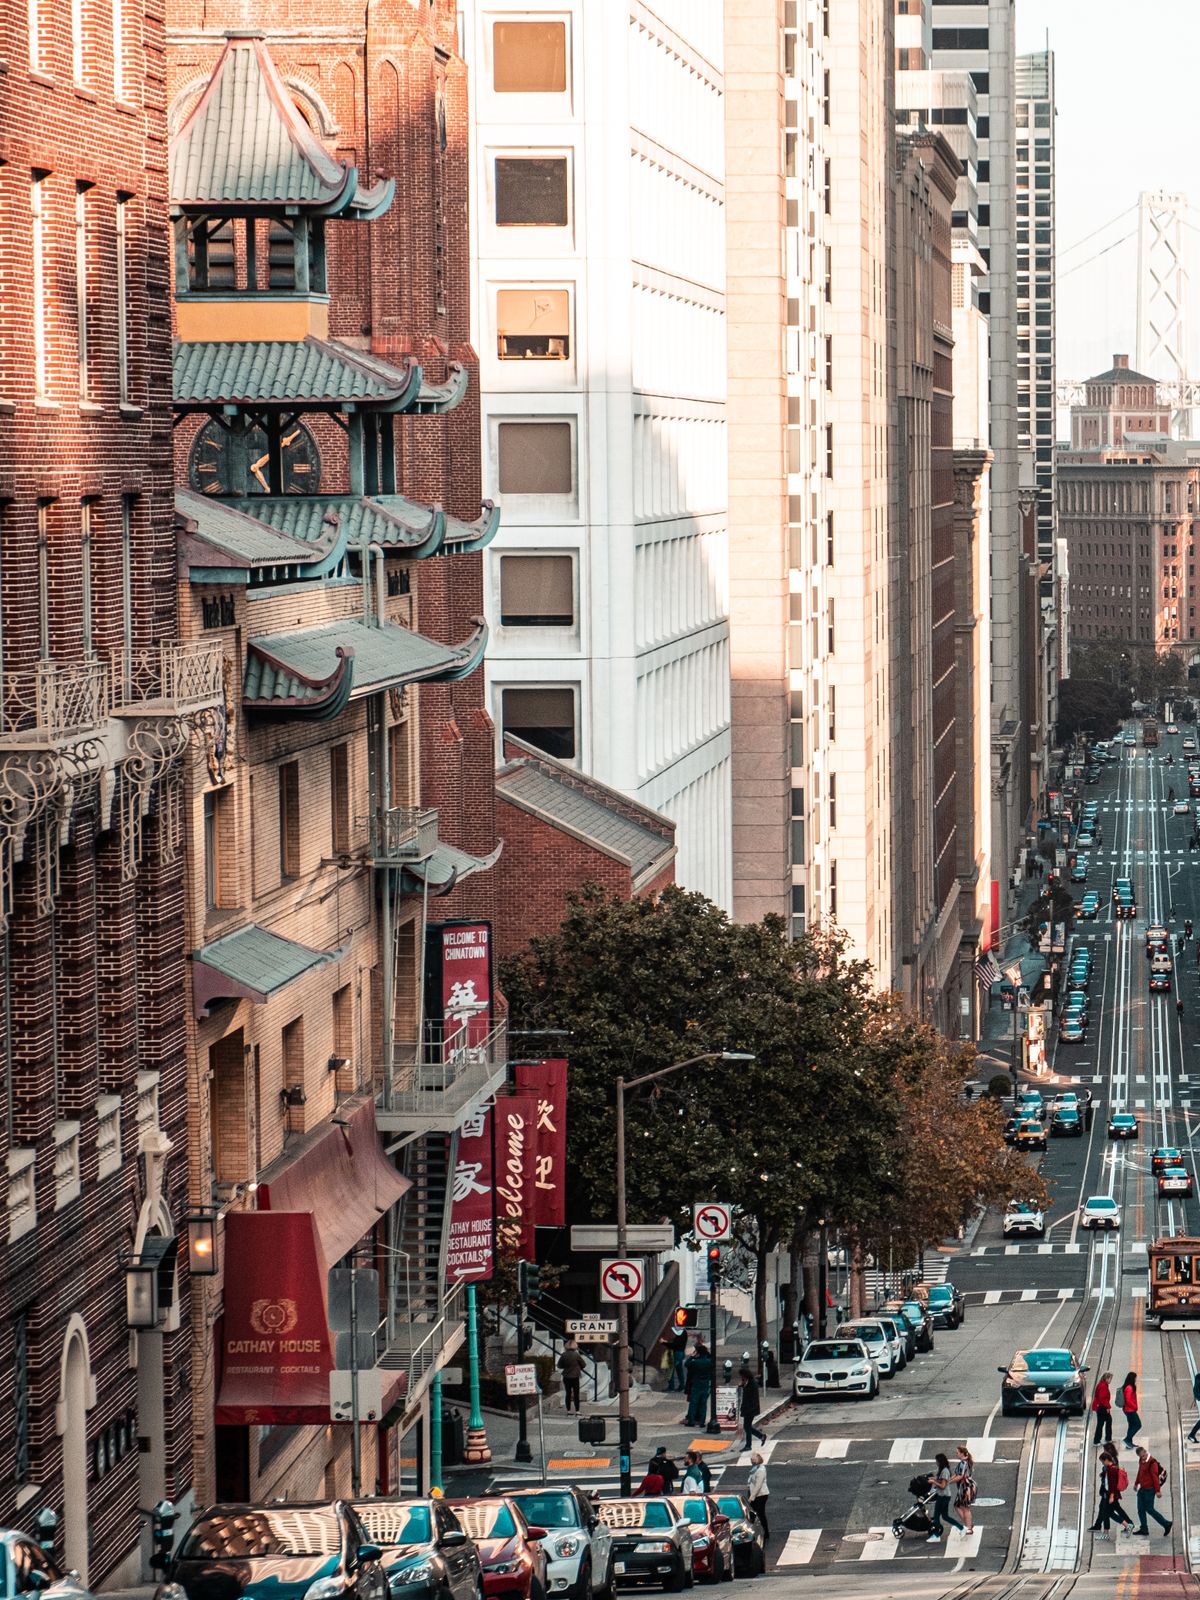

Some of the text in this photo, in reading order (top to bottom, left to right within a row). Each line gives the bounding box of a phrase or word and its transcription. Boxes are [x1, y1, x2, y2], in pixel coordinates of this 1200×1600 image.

[443, 930, 488, 946] WELCOME TO
[445, 946, 485, 960] CHINATOWN
[450, 1219, 492, 1235] ATHAY HOUSE
[446, 1249, 484, 1265] COCKTAILS
[570, 1322, 613, 1330] GRANT
[227, 1340, 320, 1353] CATHAY HOUSE
[226, 1366, 320, 1374] RESTAURANT COCKTAILS
